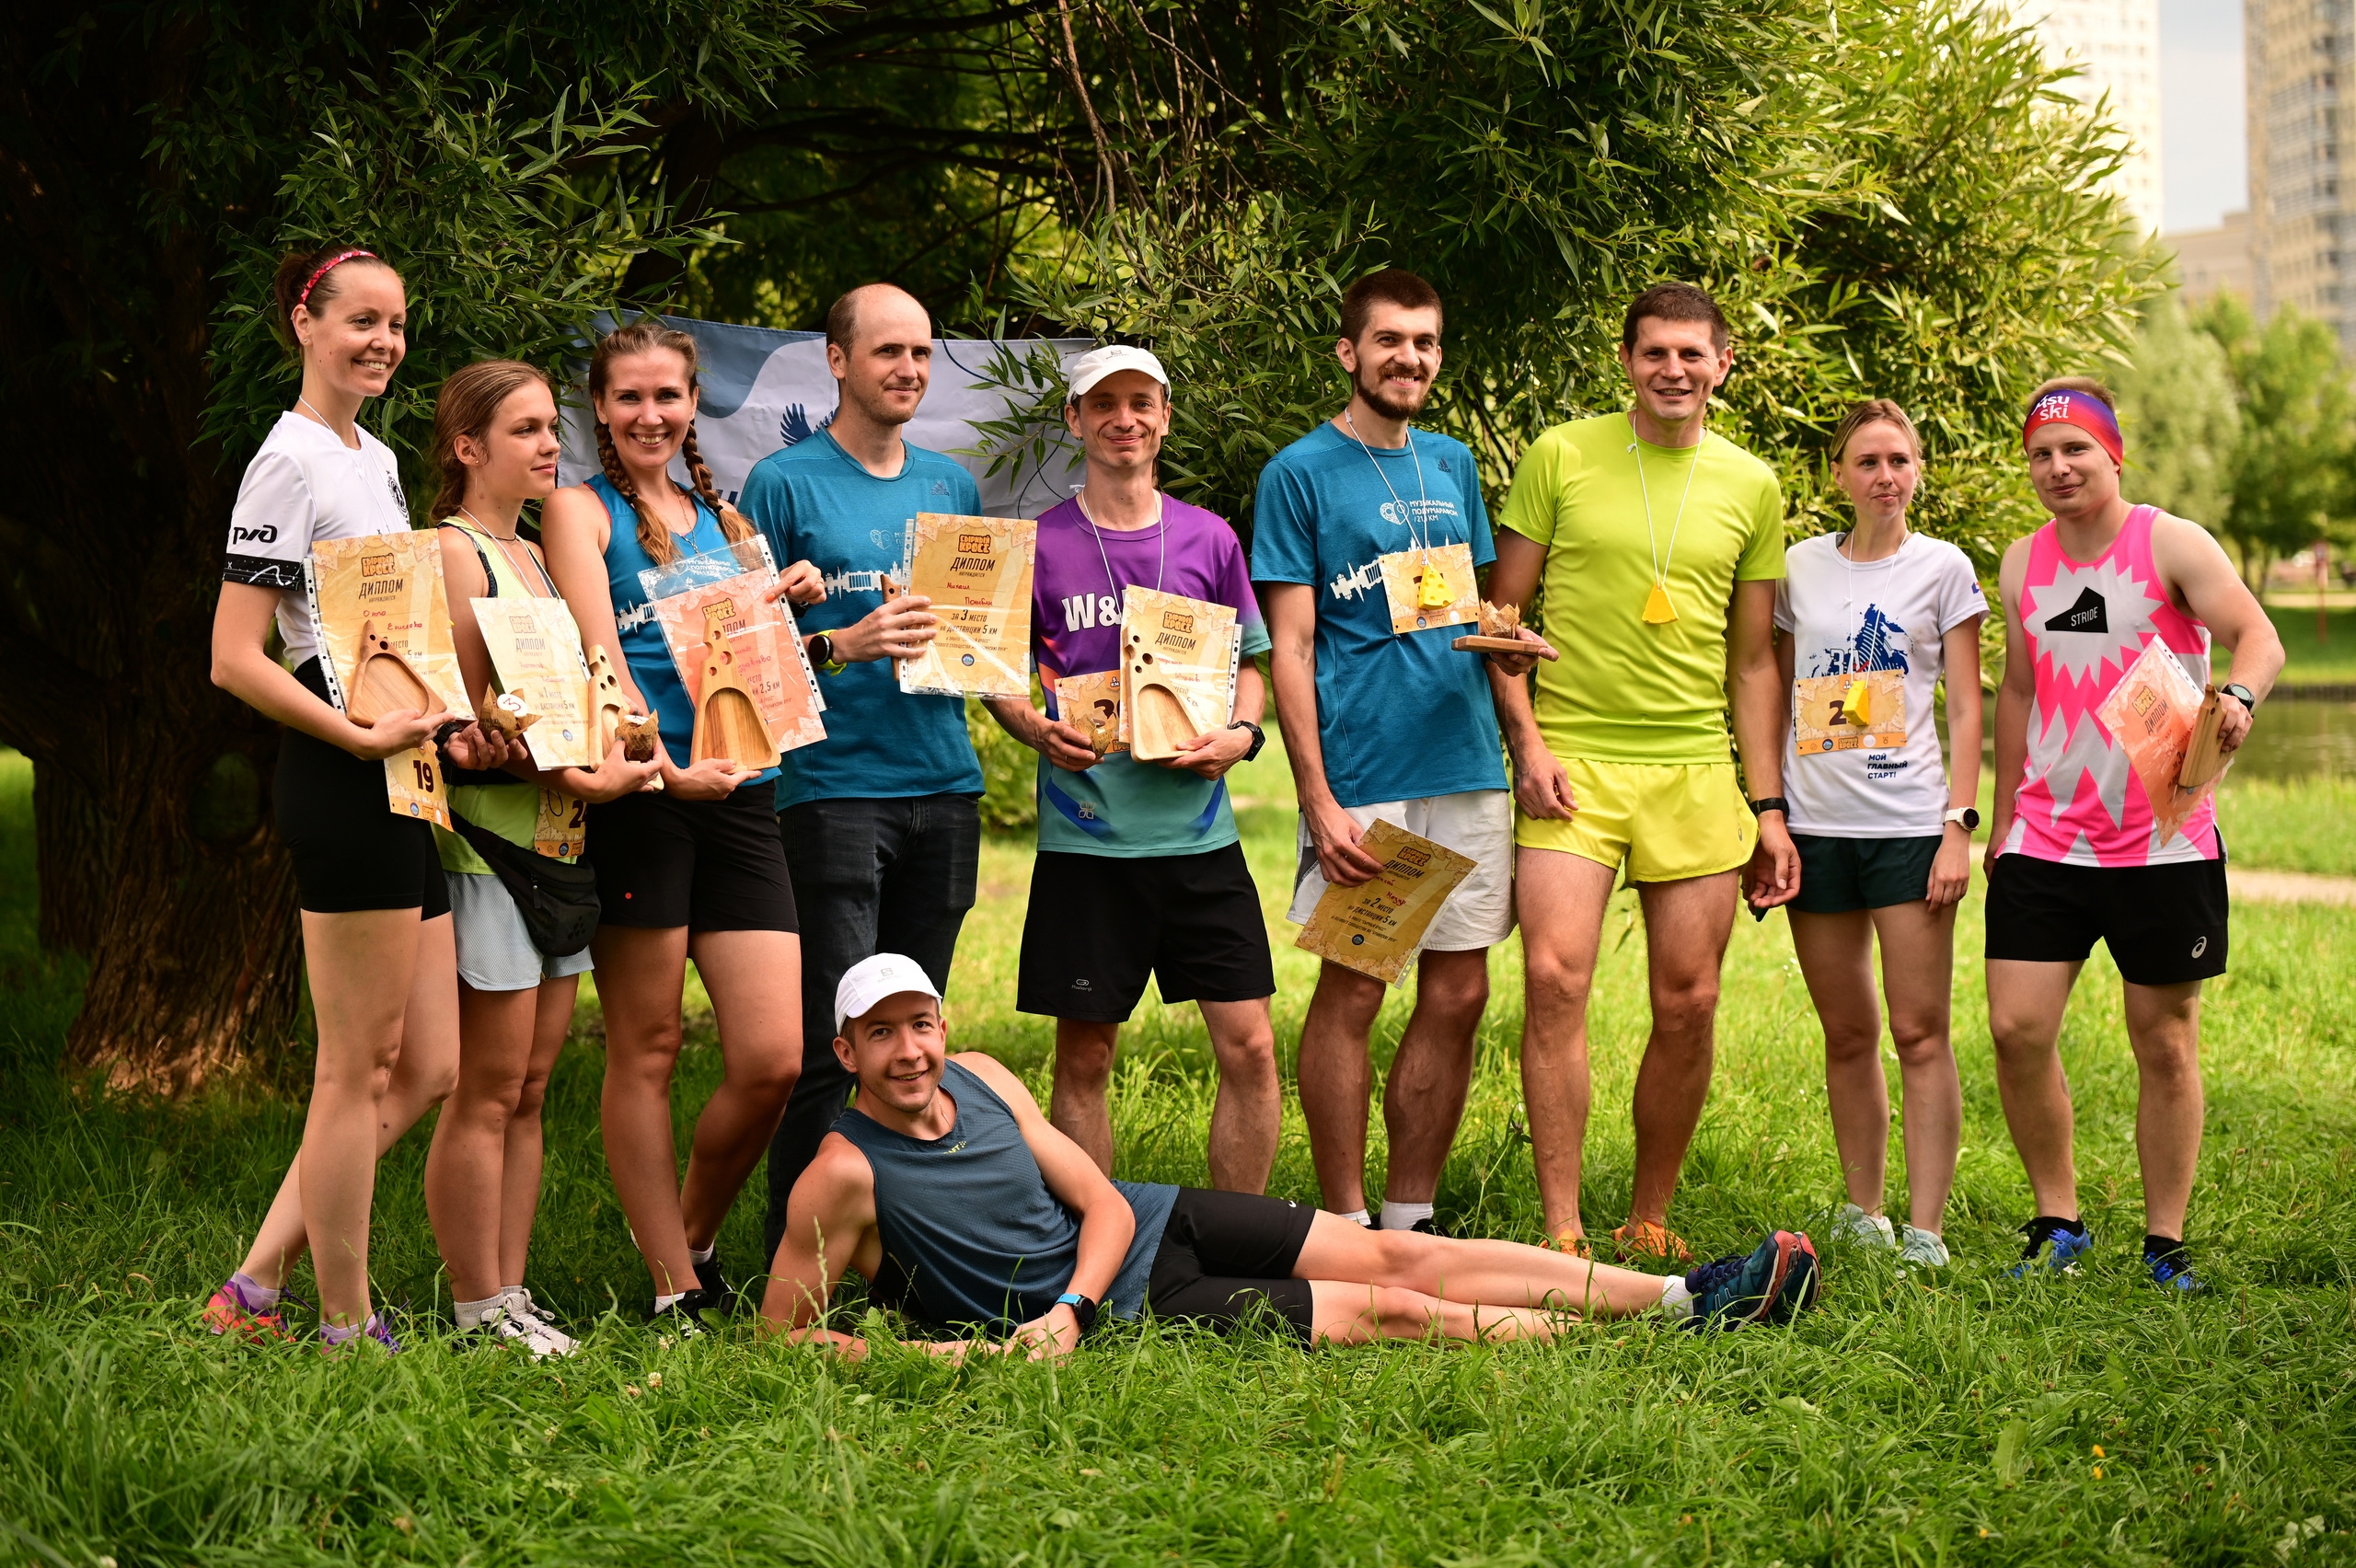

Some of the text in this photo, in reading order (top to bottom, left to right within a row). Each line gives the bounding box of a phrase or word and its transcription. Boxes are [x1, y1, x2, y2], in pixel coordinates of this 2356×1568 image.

[2039, 405, 2069, 421] ski
[958, 541, 990, 554] КРОСС
[959, 535, 991, 545] СЫРНЫЙ
[950, 557, 996, 571] ДИПЛОМ
[358, 578, 403, 600] ДИПЛОМ
[702, 598, 733, 616] СЫРНЫЙ
[951, 608, 987, 623] ЗА 3 МЕСТО
[2071, 606, 2098, 627] STRIDE
[982, 625, 988, 634] 5
[1162, 618, 1193, 633] КРОСС
[515, 638, 546, 652] ДИПЛОМ
[1155, 632, 1196, 650] ДИПЛОМ
[759, 682, 771, 694] 2,5
[563, 699, 569, 709] 5
[2144, 699, 2169, 736] ДИПЛОМ
[1868, 753, 1887, 761] МОЙ
[2177, 751, 2182, 765] 3
[1867, 761, 1908, 769] ГЛАВНЫЙ
[413, 760, 434, 793] 19
[1867, 771, 1896, 779] СТАРТ!
[1384, 859, 1425, 879] ДИПЛОМ
[1369, 897, 1381, 908] 2
[1377, 904, 1394, 914] МЕСТО
[1352, 906, 1383, 921] ДИСТАНЦИИ
[1382, 916, 1391, 924] 5
